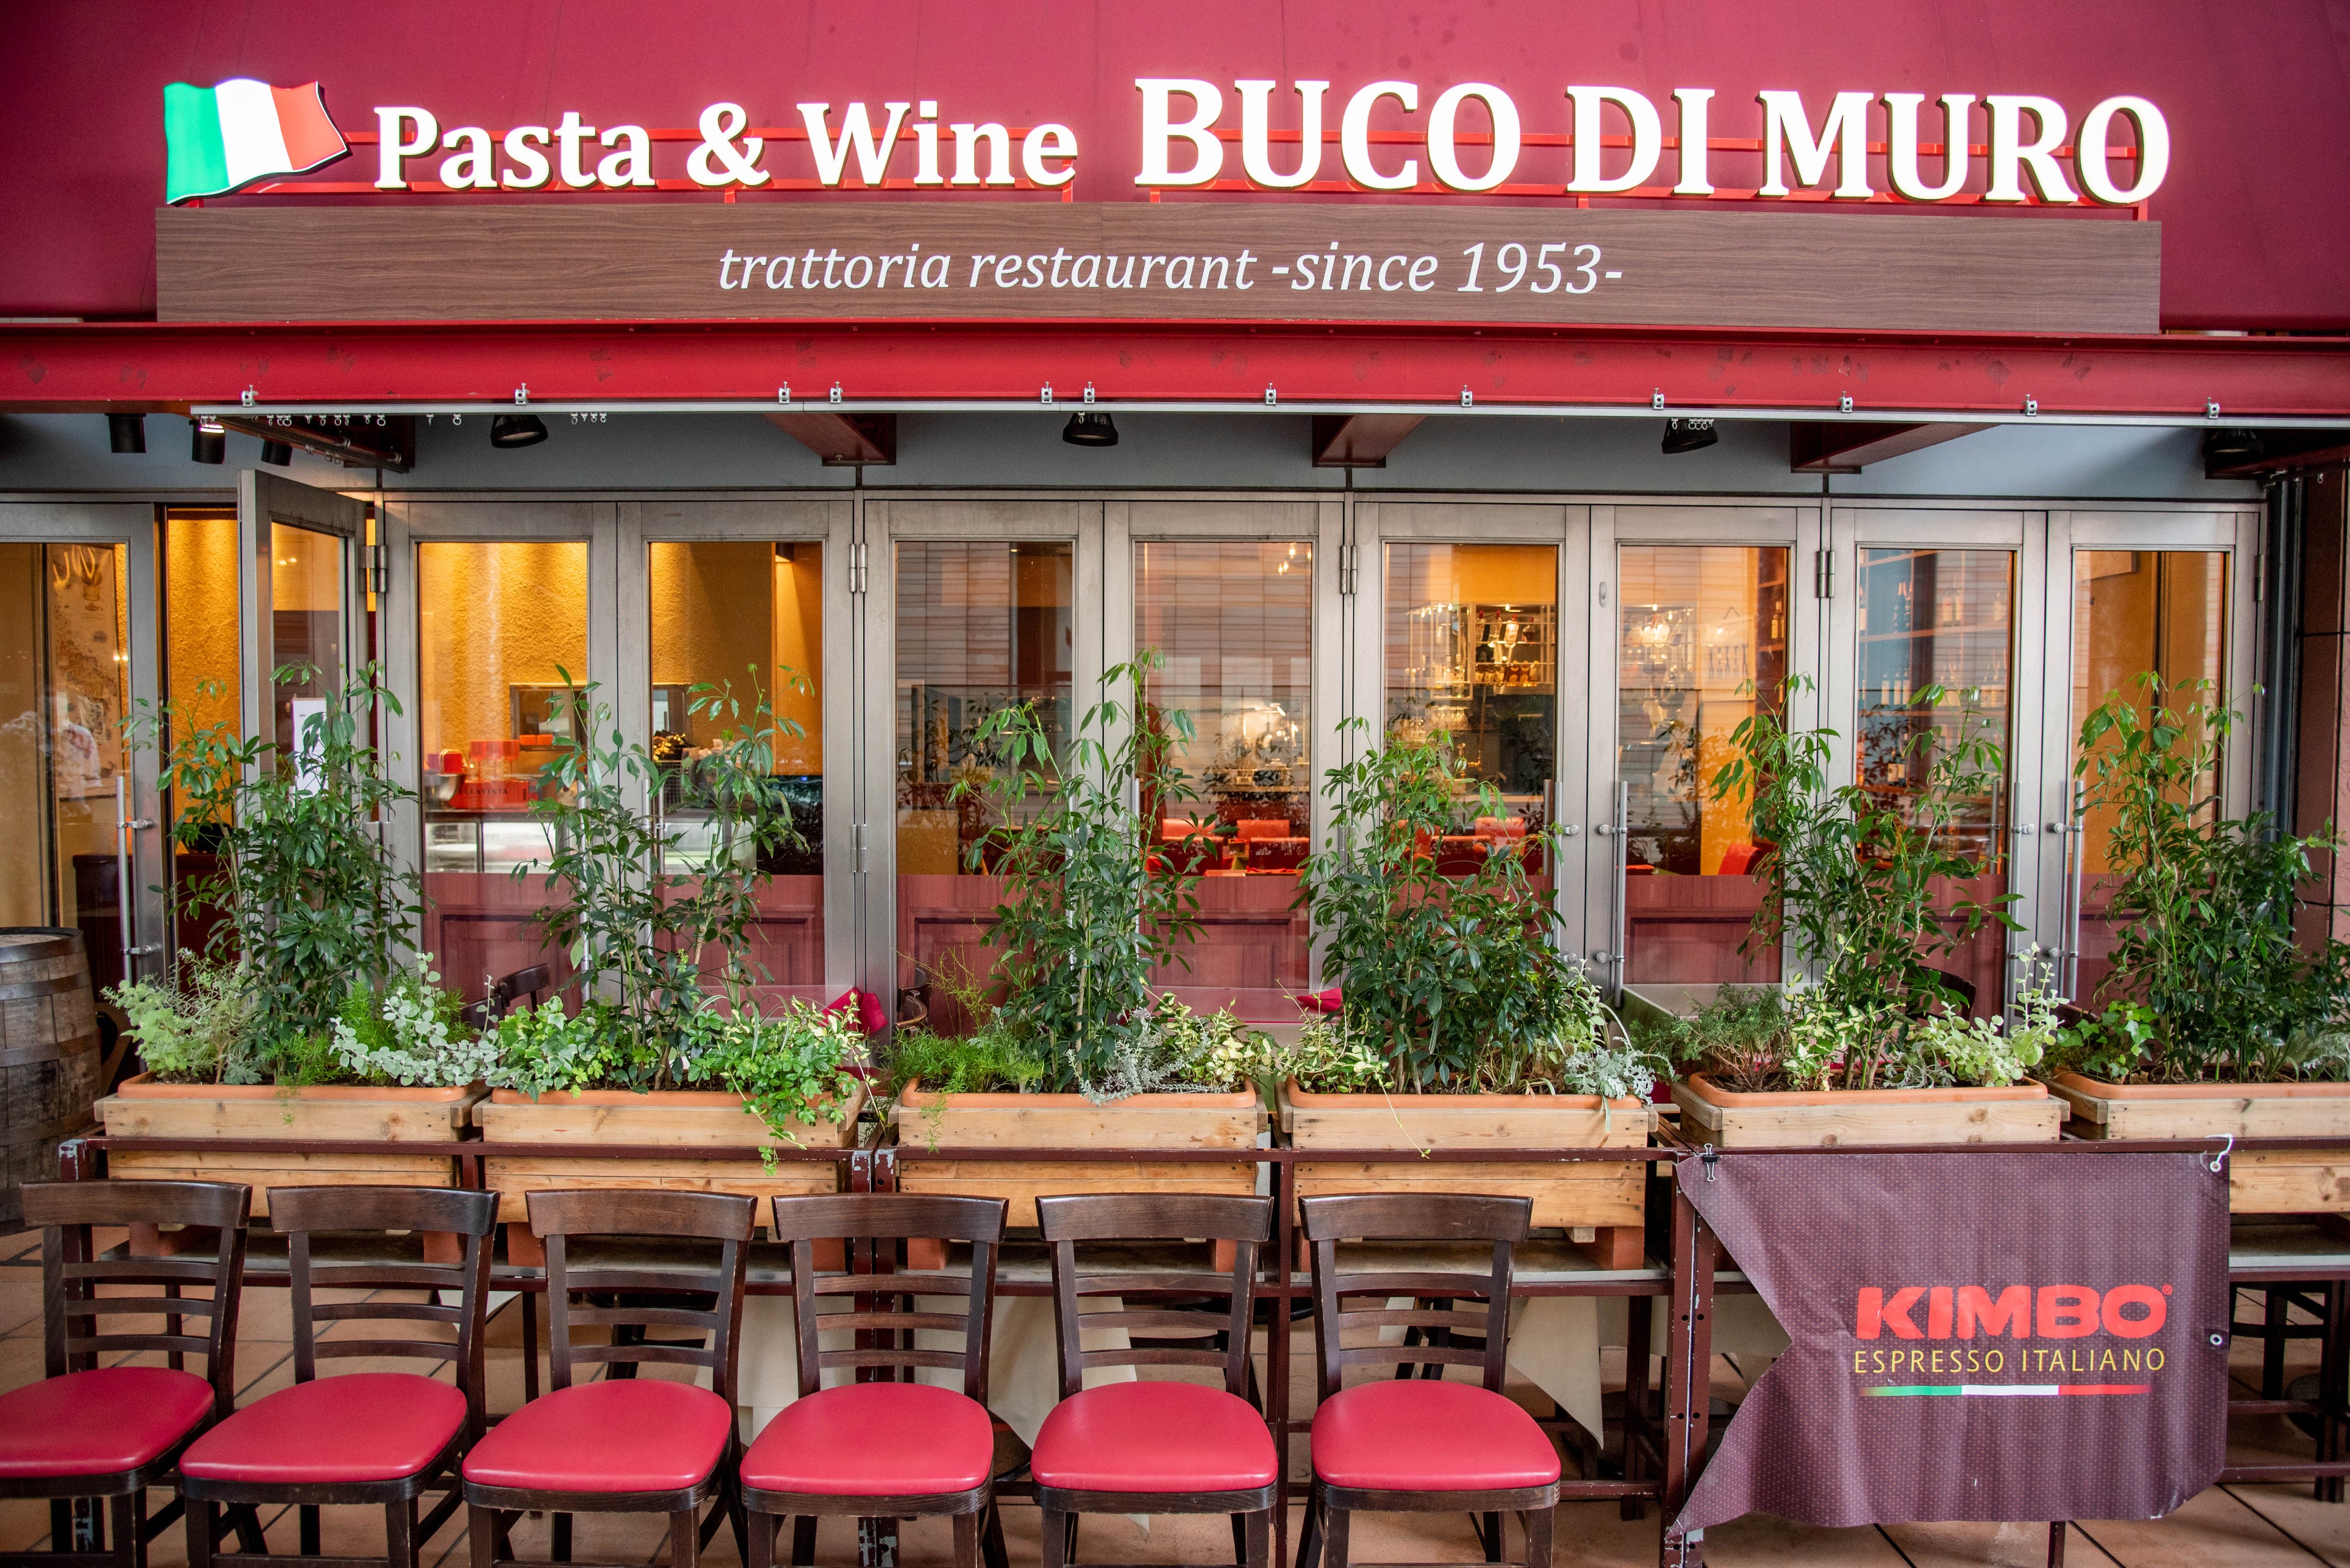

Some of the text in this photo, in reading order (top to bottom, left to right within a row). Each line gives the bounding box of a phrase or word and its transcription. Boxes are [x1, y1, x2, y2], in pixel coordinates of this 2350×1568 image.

[374, 77, 2170, 205] Pasta & Wine BUCO DI MURO
[719, 239, 1623, 294] trattoria restaurant -since 1953-
[1854, 1348, 2166, 1373] ESPRESSO ITALIANO
